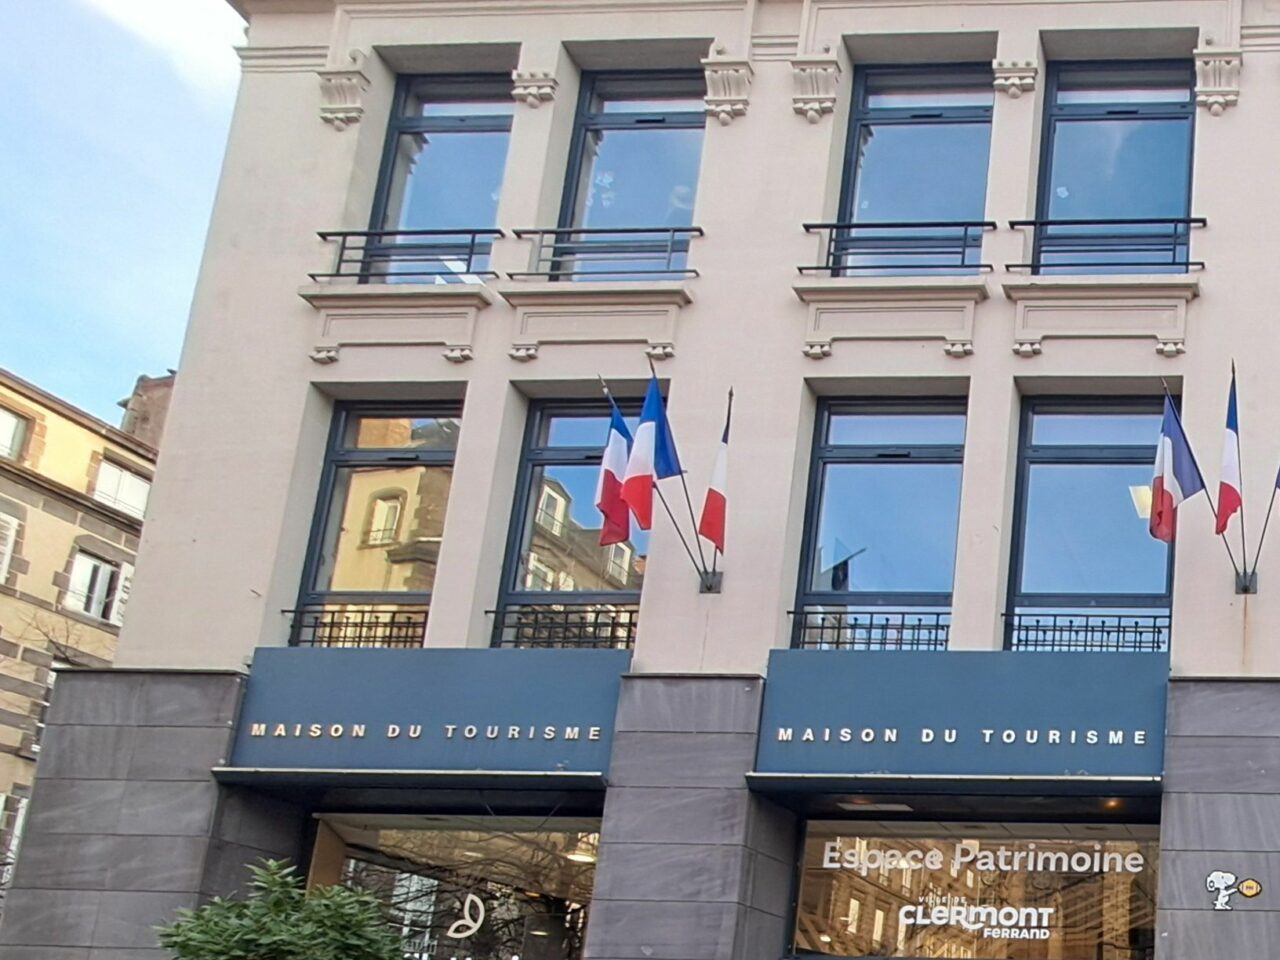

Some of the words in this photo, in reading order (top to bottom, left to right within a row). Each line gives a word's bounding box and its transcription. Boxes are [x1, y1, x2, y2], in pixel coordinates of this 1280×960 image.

[251, 723, 366, 739] MAISON
[387, 725, 423, 739] DU
[445, 724, 601, 742] TOURISME
[778, 727, 898, 743] MAISON
[922, 728, 957, 744] DU
[983, 729, 1147, 745] TOURISME
[822, 841, 944, 877] Espace
[953, 843, 1145, 873] Patrimoine
